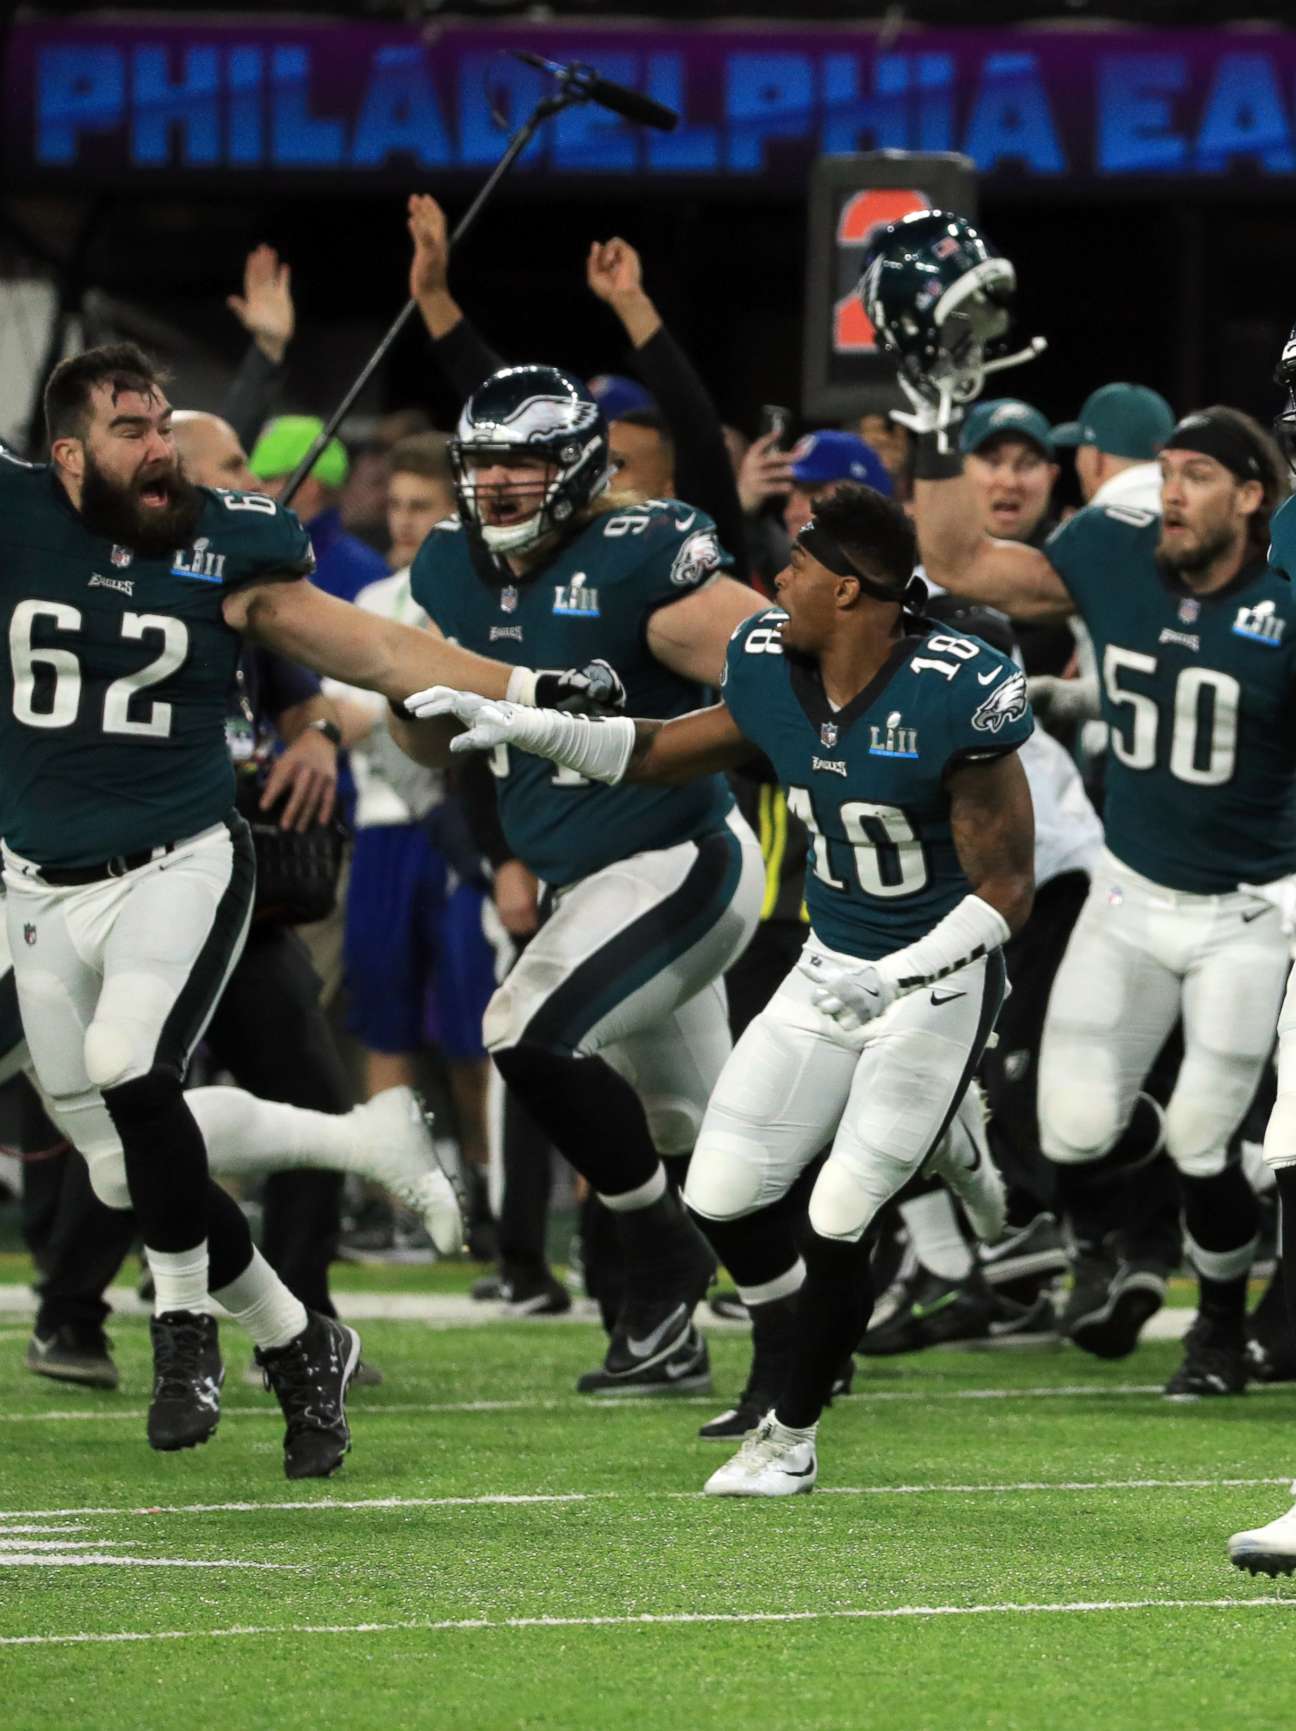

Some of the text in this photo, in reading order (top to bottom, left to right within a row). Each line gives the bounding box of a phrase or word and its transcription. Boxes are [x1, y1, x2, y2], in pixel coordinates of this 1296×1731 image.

[34, 43, 1064, 175] PHILADELPHIA
[87, 572, 136, 597] EAGLES
[9, 599, 189, 738] 62
[910, 635, 980, 681] 18
[1103, 644, 1241, 786] 50
[811, 756, 848, 778] EAGLES
